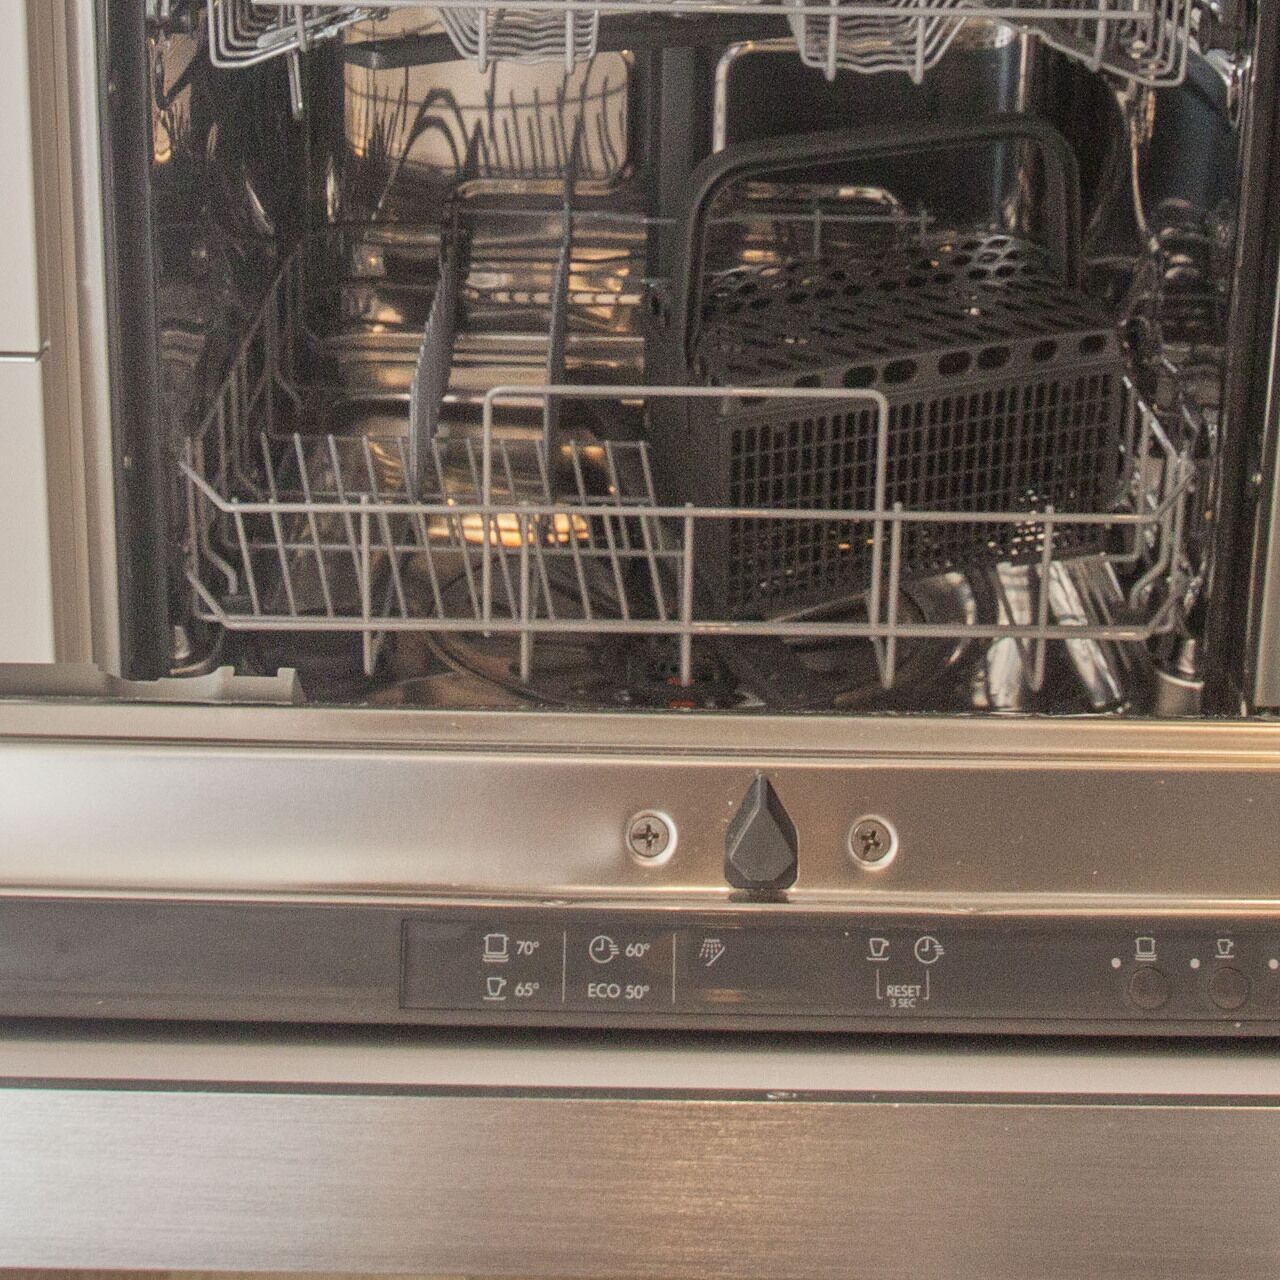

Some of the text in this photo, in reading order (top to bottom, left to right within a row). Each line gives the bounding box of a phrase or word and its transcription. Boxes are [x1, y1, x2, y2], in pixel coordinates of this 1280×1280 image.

[587, 983, 620, 998] ECO
[886, 985, 921, 997] RESET
[889, 998, 916, 1008] 3 SEC
